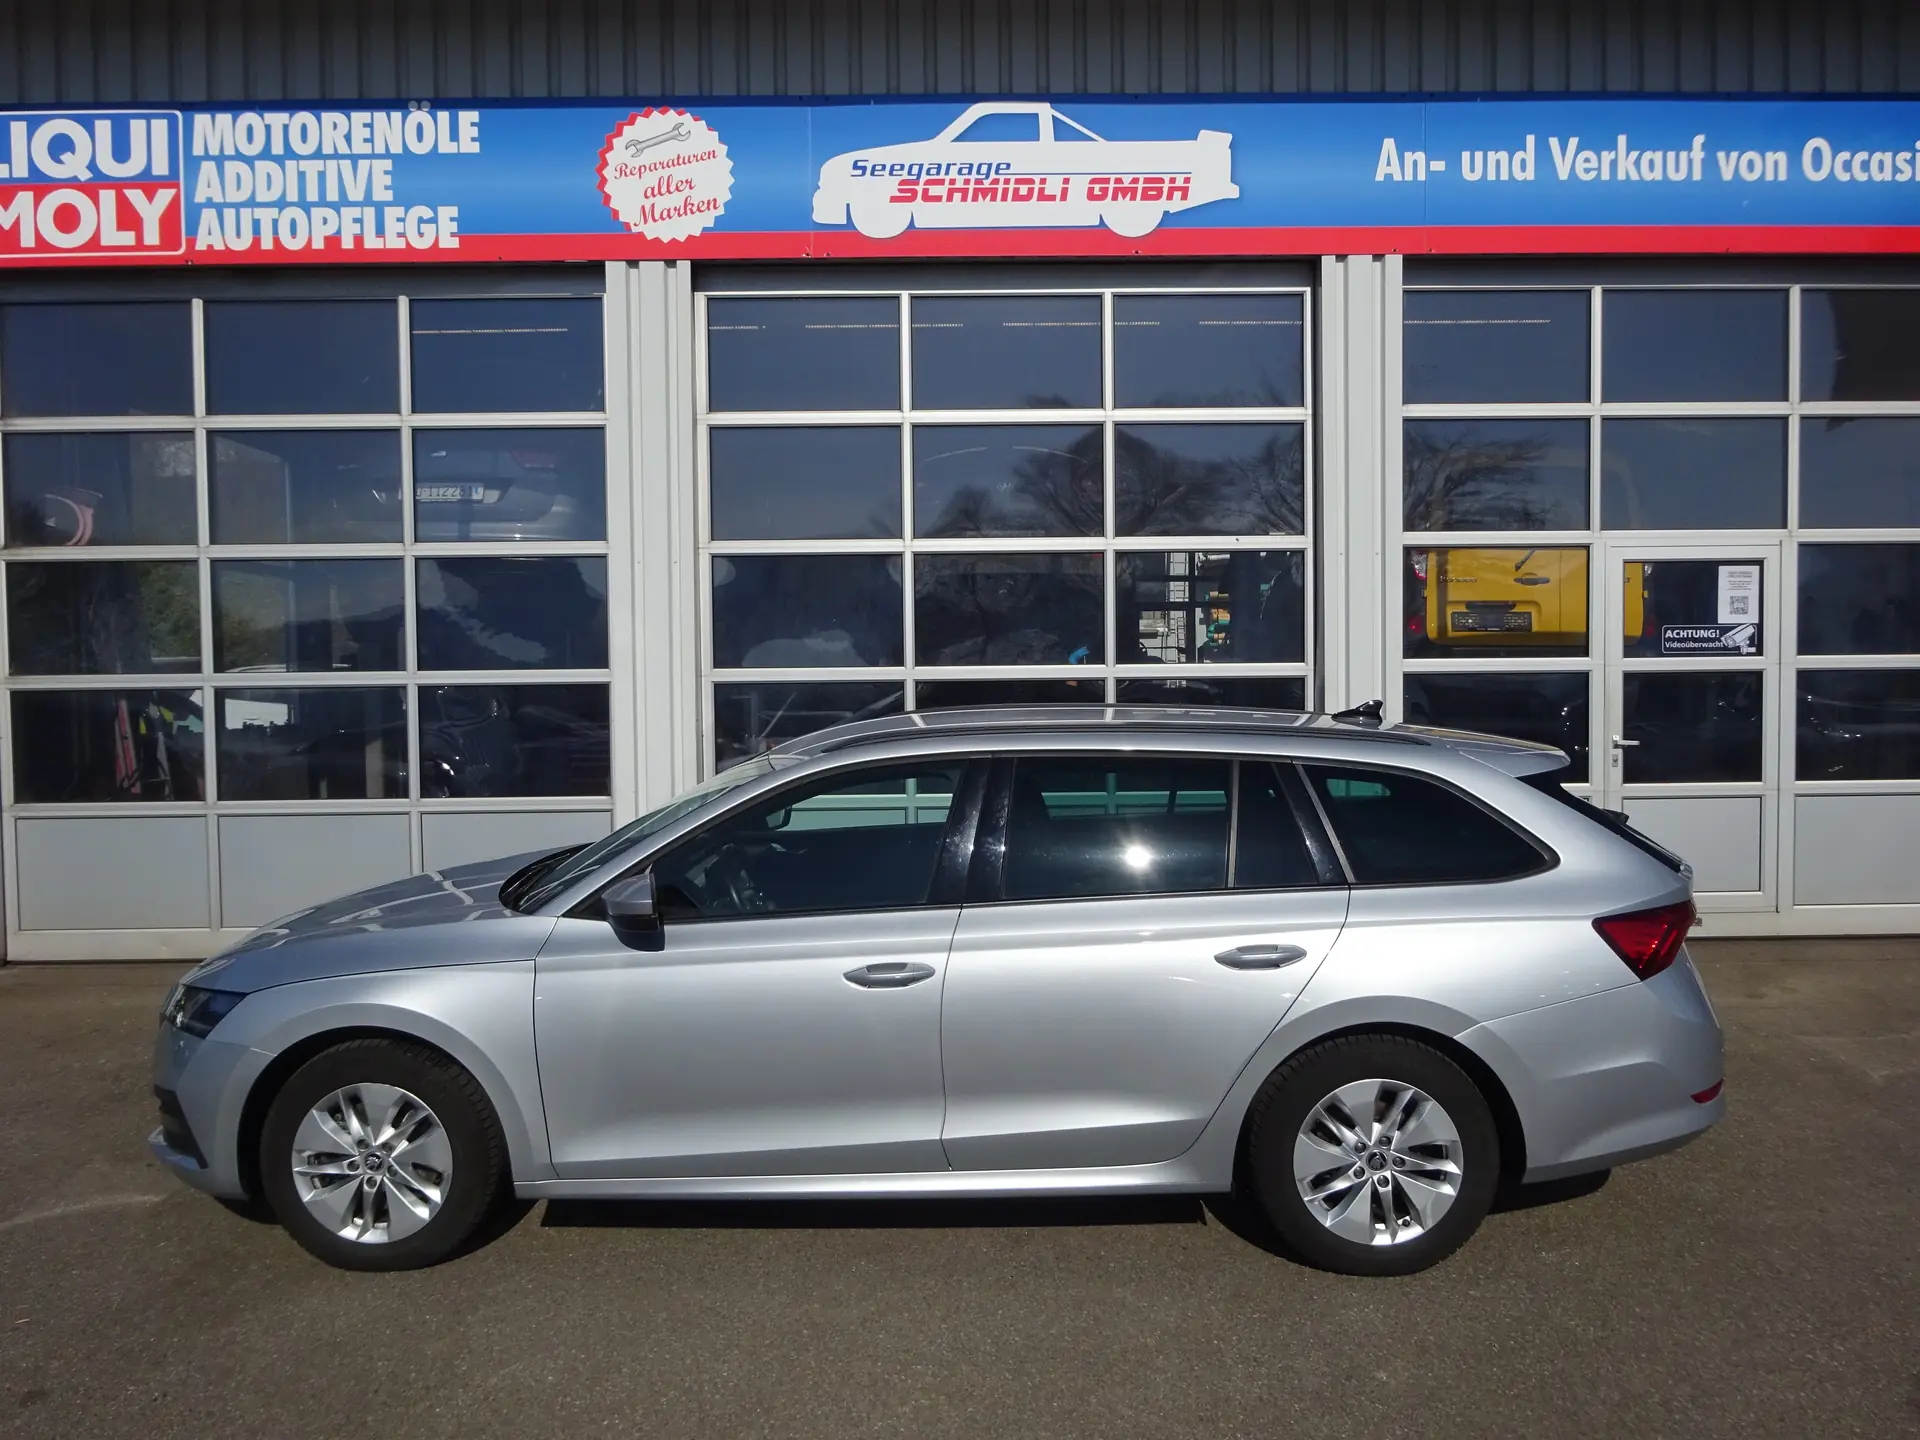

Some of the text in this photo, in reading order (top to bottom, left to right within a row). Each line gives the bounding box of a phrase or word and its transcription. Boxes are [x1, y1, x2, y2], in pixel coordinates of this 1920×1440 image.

[192, 101, 480, 156] MOTORENÖLE
[0, 118, 169, 182] IQUI
[614, 149, 718, 180] Reparaturen
[1375, 137, 1446, 182] An-
[1461, 134, 1536, 182] und
[1548, 134, 1706, 182] Verkauf
[1717, 150, 1788, 182] von
[194, 159, 394, 203] ADDITIVE
[643, 173, 696, 200] aller
[850, 159, 1011, 182] Seegarage
[889, 176, 1191, 204] SCHMIDLI GMBH
[633, 195, 720, 227] Marken
[194, 205, 460, 251] AUTOPFLEGE
[1665, 629, 1720, 638] ACHTUNG!
